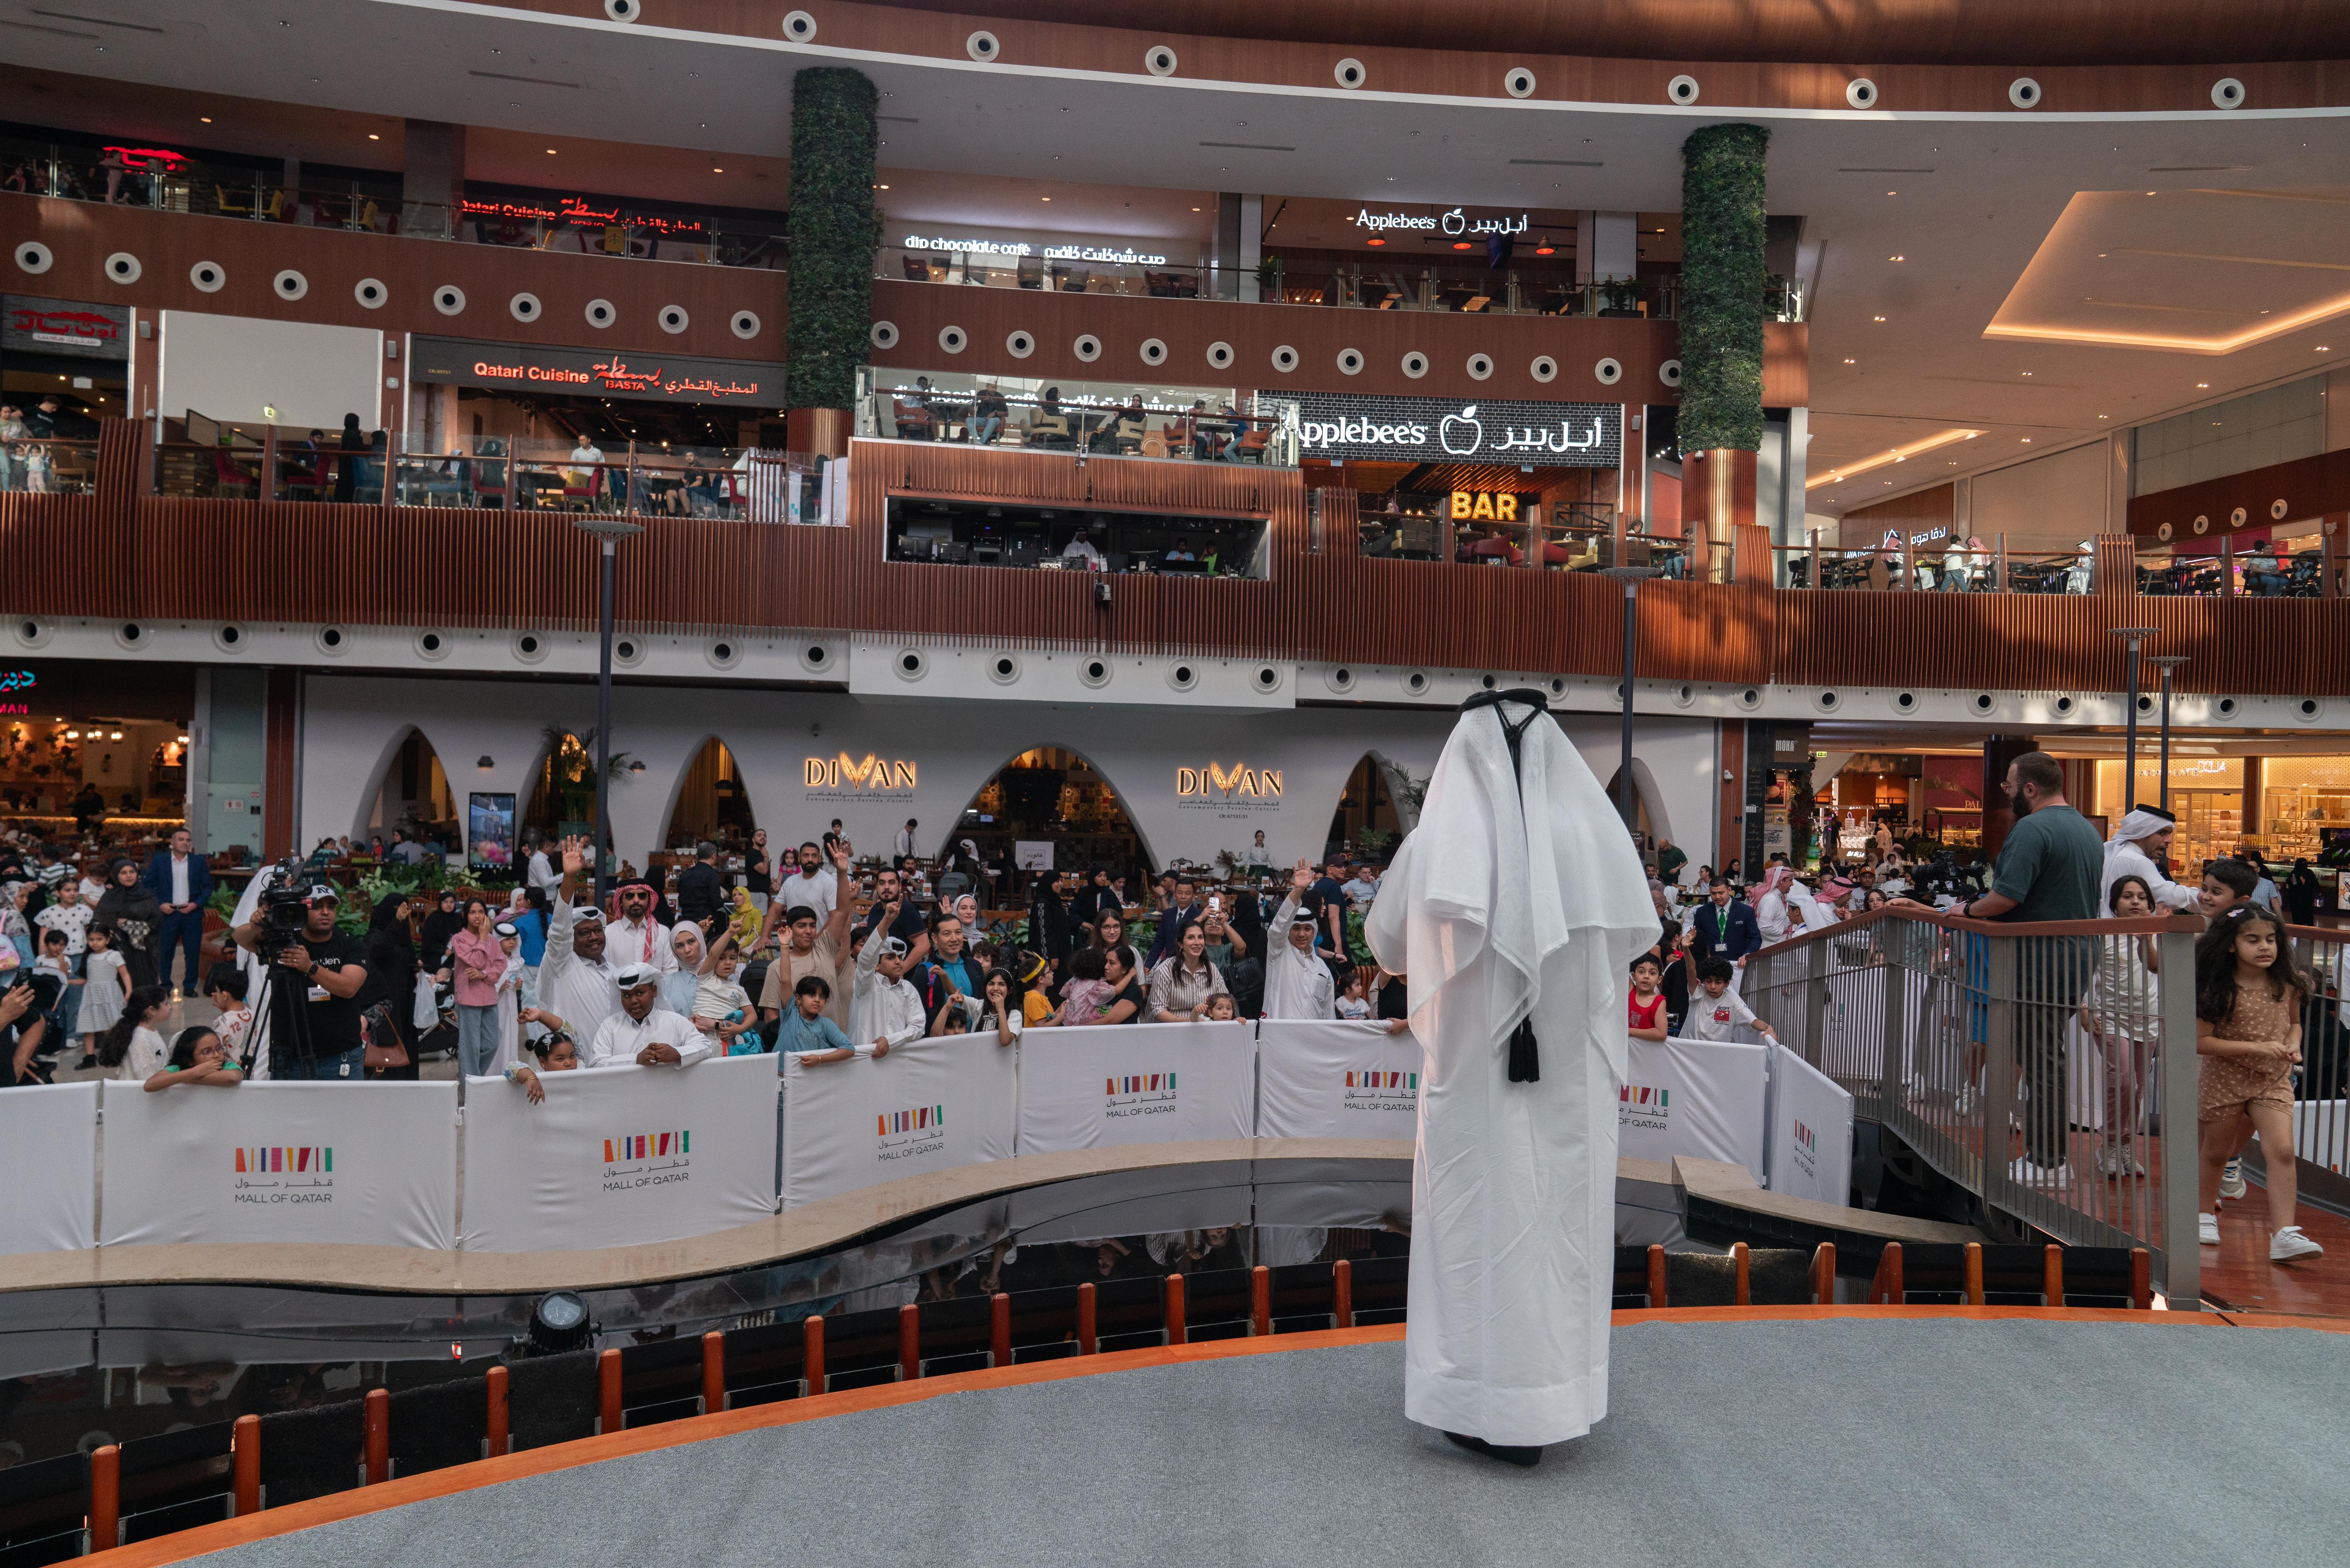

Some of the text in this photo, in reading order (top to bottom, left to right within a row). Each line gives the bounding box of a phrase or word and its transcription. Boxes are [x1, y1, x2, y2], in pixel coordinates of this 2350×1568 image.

[1356, 209, 1435, 230] Applebee's
[905, 235, 1031, 256] dip chocolate café
[474, 362, 590, 384] Qatari Cuisine
[605, 380, 646, 391] BASTA
[665, 378, 758, 398] المطبخ القطري
[1277, 409, 1427, 449] Applebee's
[1451, 491, 1518, 521] BAR
[1775, 739, 1795, 752] MOKA
[806, 752, 915, 790] DIVAN
[1179, 761, 1281, 798] DIVAN
[1107, 1092, 1176, 1107] قطر مول
[1345, 1090, 1416, 1099] قطر مول
[1107, 1110, 1129, 1118] MALL
[1144, 1105, 1176, 1114] QATAR
[1382, 1103, 1415, 1112] QATAR
[1628, 1107, 1668, 1117] قطر
[1632, 1119, 1667, 1131] QATAR
[878, 1130, 944, 1149] قطر مول
[878, 1142, 944, 1162] MALL OF QATAR
[604, 1159, 689, 1178] قطر مول
[235, 1177, 333, 1188] قطر مول
[603, 1172, 689, 1192] MALL OF QATAR
[235, 1193, 332, 1203] MALL OF QATAR
